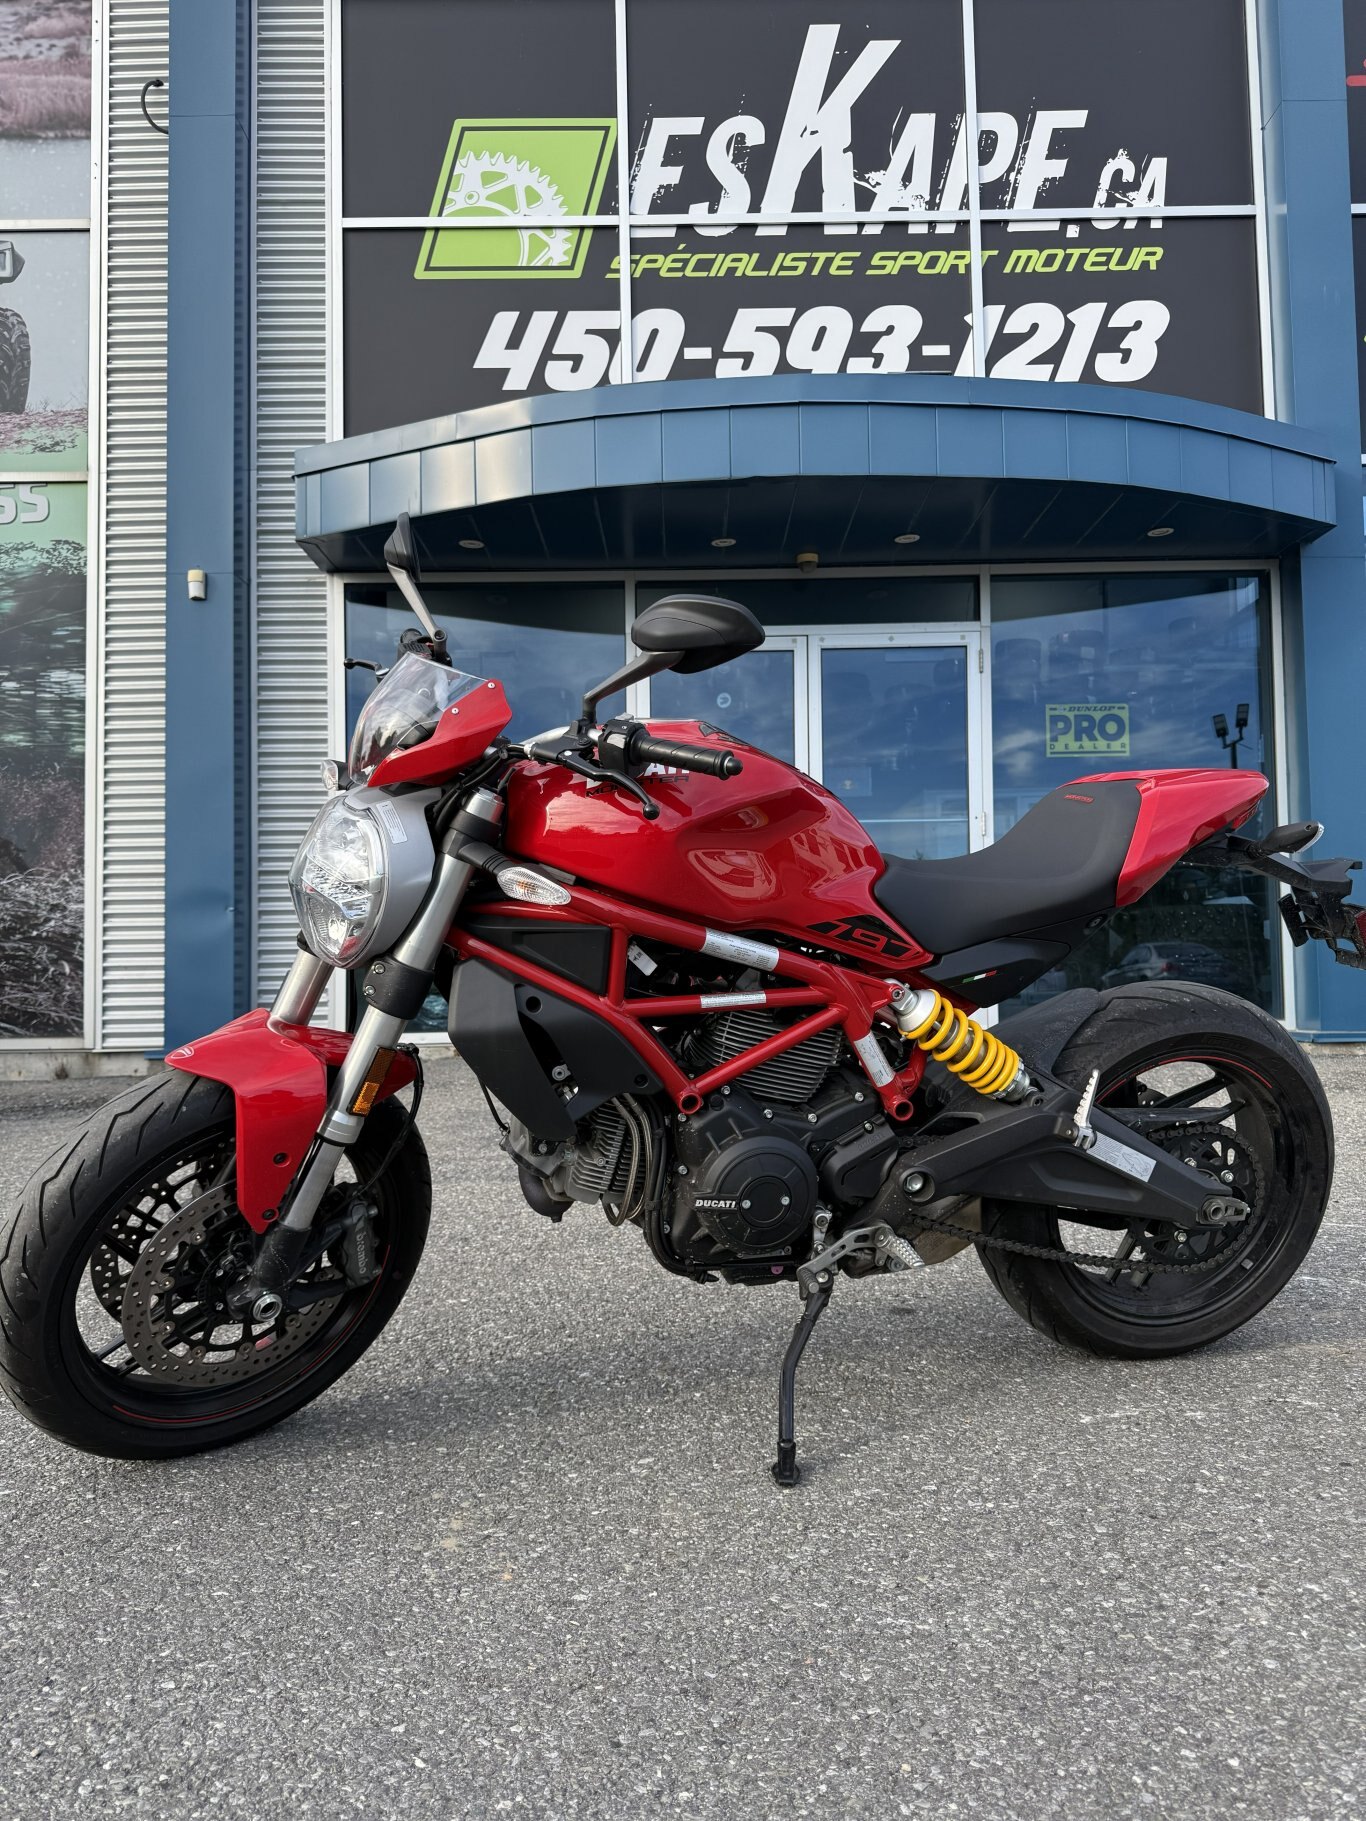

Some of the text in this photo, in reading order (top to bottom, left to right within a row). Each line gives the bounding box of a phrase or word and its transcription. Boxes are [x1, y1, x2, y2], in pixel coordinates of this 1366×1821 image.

[605, 243, 861, 279] SPÉCIALISTE
[1003, 247, 1163, 274] MOTEUR
[473, 300, 1170, 392] 450-593-1213
[1068, 705, 1116, 713] DUNLOP
[1049, 713, 1126, 742] PRO
[1049, 743, 1126, 751] DEALER
[695, 1199, 736, 1208] DUCATI
[356, 1231, 368, 1274] brembo
